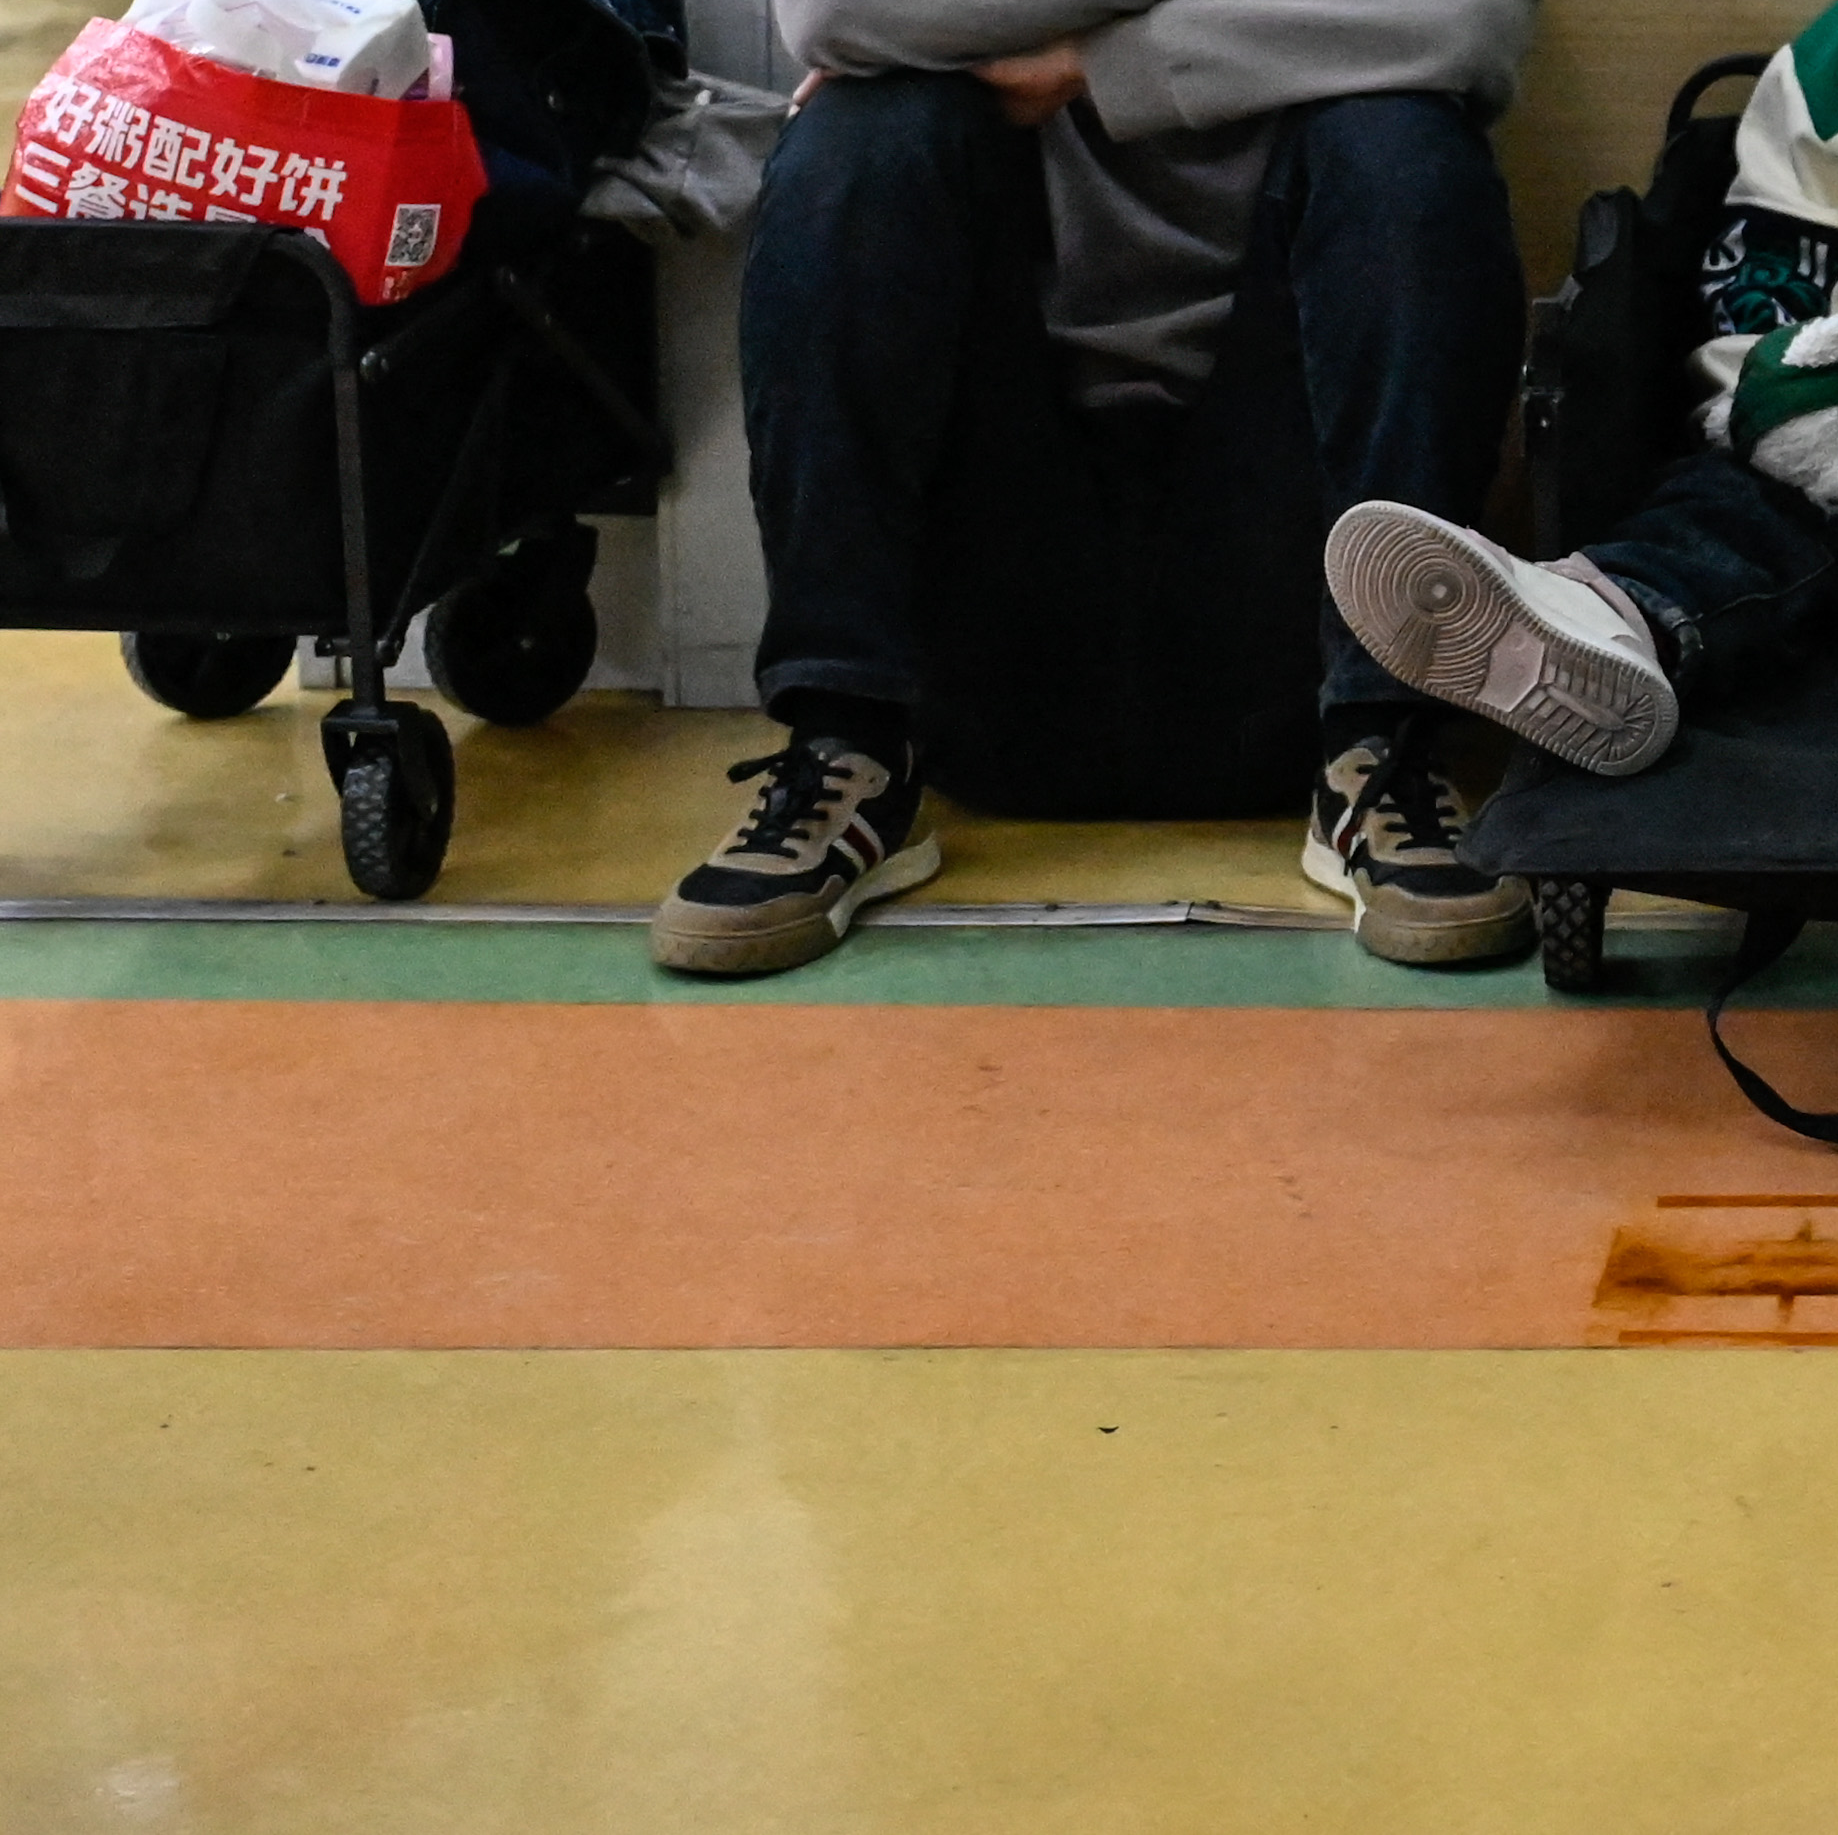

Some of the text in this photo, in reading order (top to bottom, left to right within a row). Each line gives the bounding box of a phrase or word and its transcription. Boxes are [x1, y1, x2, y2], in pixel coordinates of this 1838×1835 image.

[15, 140, 331, 250] 三餐选
[42, 81, 348, 221] 好粥配好饼
